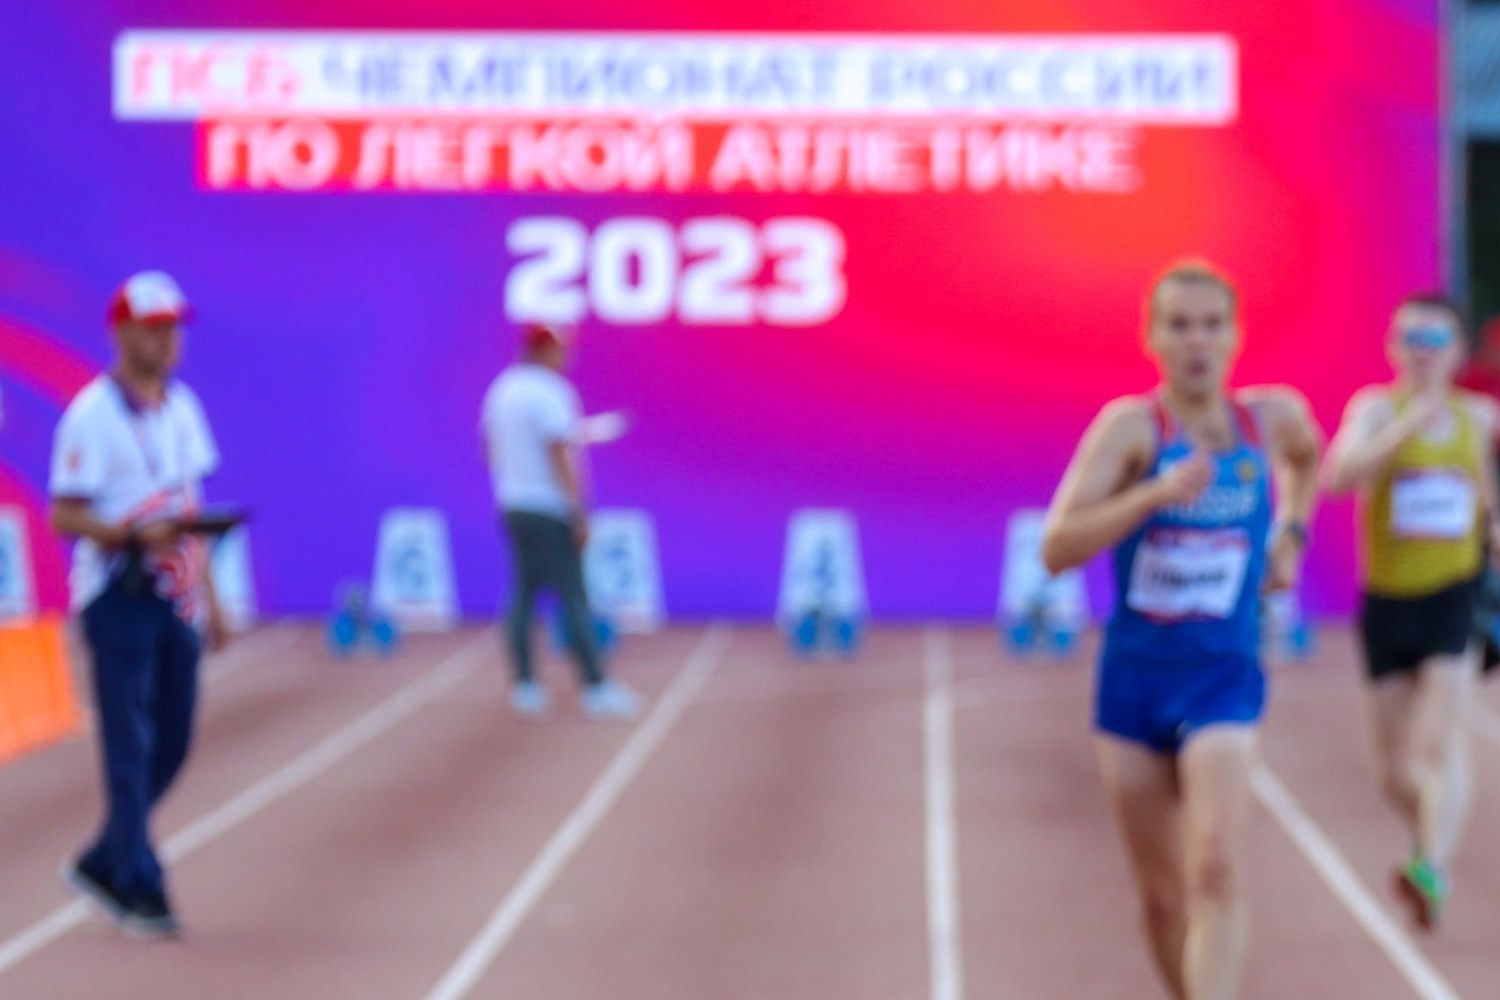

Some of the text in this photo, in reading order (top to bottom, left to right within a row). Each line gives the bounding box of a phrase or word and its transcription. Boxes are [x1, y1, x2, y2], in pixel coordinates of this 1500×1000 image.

[131, 42, 1210, 108] ПСБ ЧЕМПИОНАТ РОССИИ
[206, 116, 1144, 193] ПО ЛЕГКОЙ АТЛЕТИКЕ
[505, 215, 847, 324] 2023
